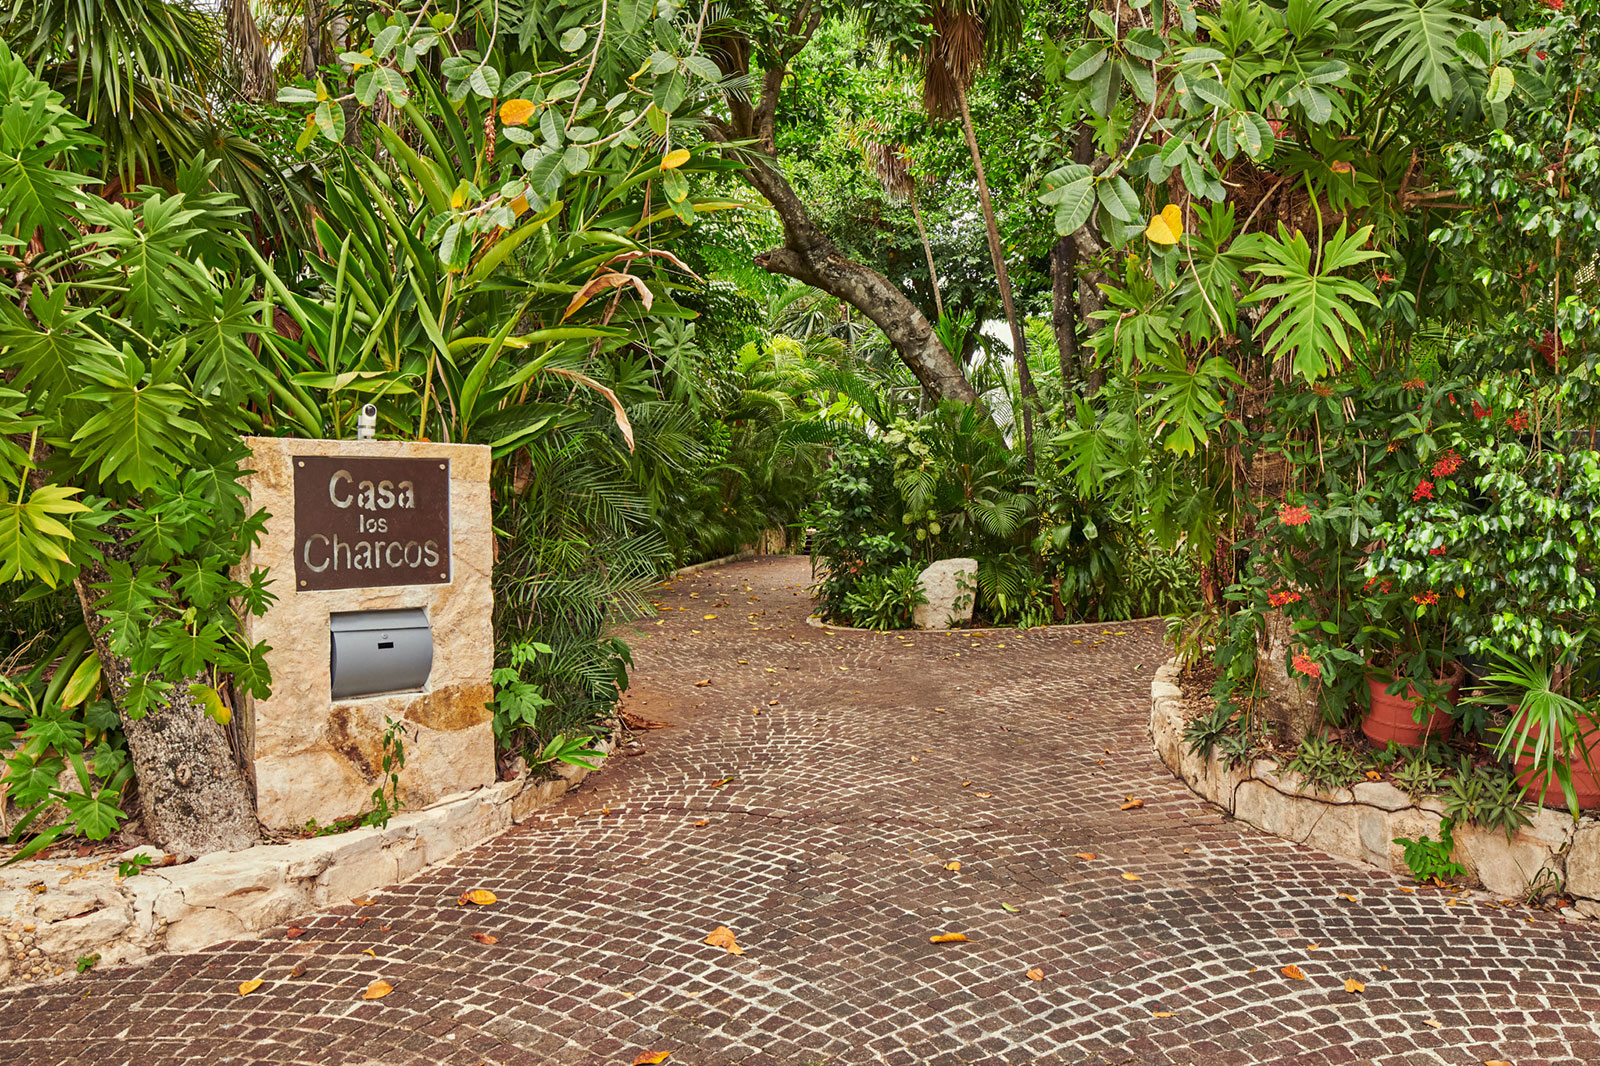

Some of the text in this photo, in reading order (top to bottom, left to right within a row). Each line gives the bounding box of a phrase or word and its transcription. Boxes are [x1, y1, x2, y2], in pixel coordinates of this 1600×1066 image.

[329, 469, 415, 511] Casa
[359, 514, 388, 533] los
[304, 533, 439, 572] Charcos
